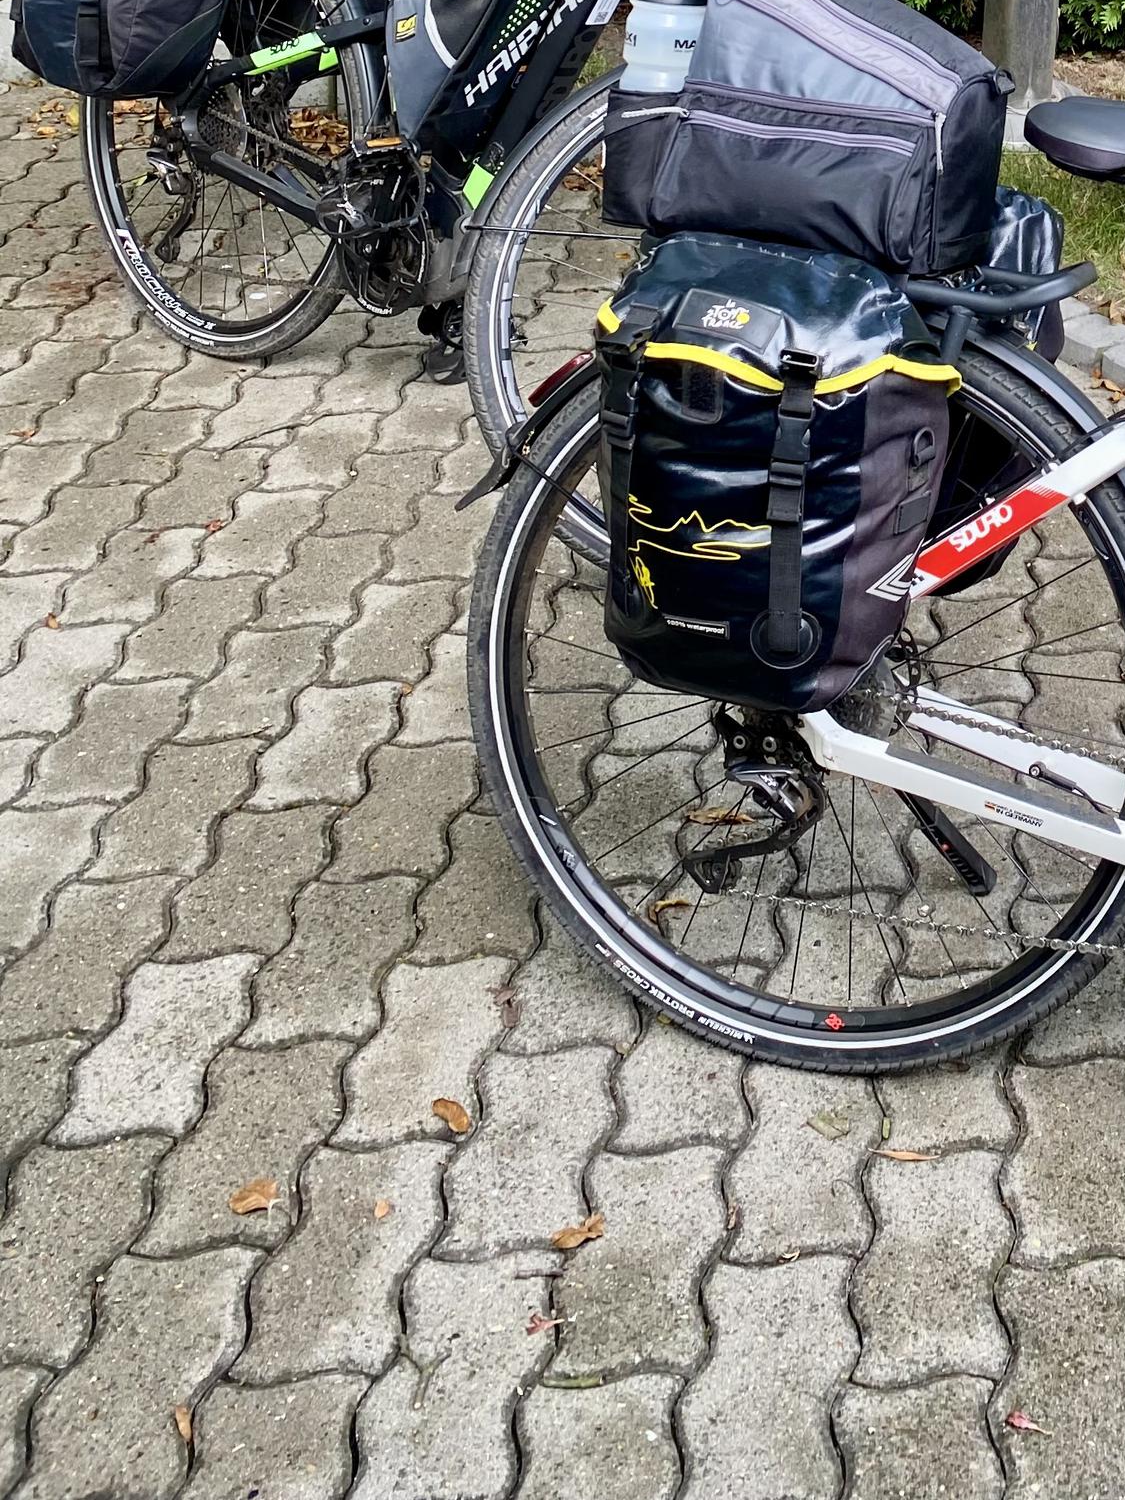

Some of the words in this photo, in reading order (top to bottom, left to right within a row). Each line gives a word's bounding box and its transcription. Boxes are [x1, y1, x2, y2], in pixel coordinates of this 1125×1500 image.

[948, 505, 1013, 552] SDURO
[613, 959, 650, 990] CROSS
[649, 986, 695, 1018] PROTEK
